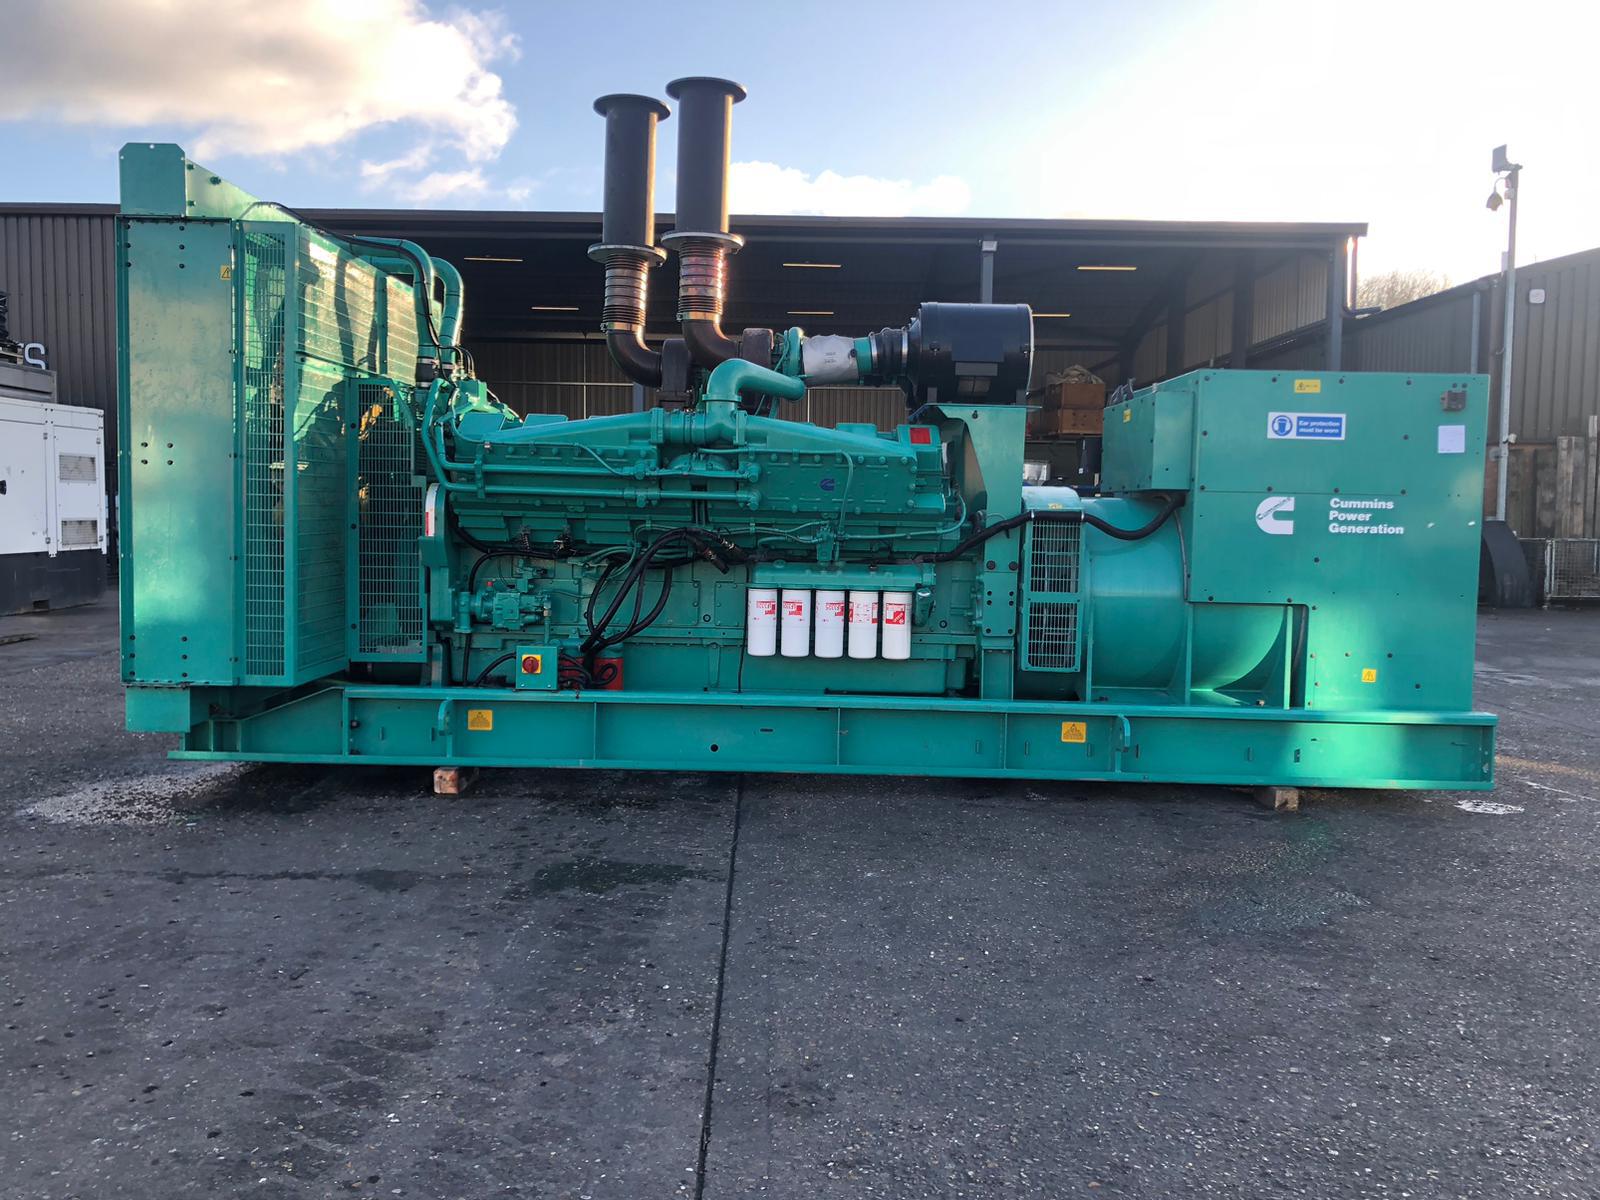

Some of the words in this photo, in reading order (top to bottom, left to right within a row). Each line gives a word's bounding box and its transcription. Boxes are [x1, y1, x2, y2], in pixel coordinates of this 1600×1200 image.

[1329, 498, 1394, 509] Cummins
[1328, 510, 1372, 521] Power
[1328, 522, 1405, 535] Generation
